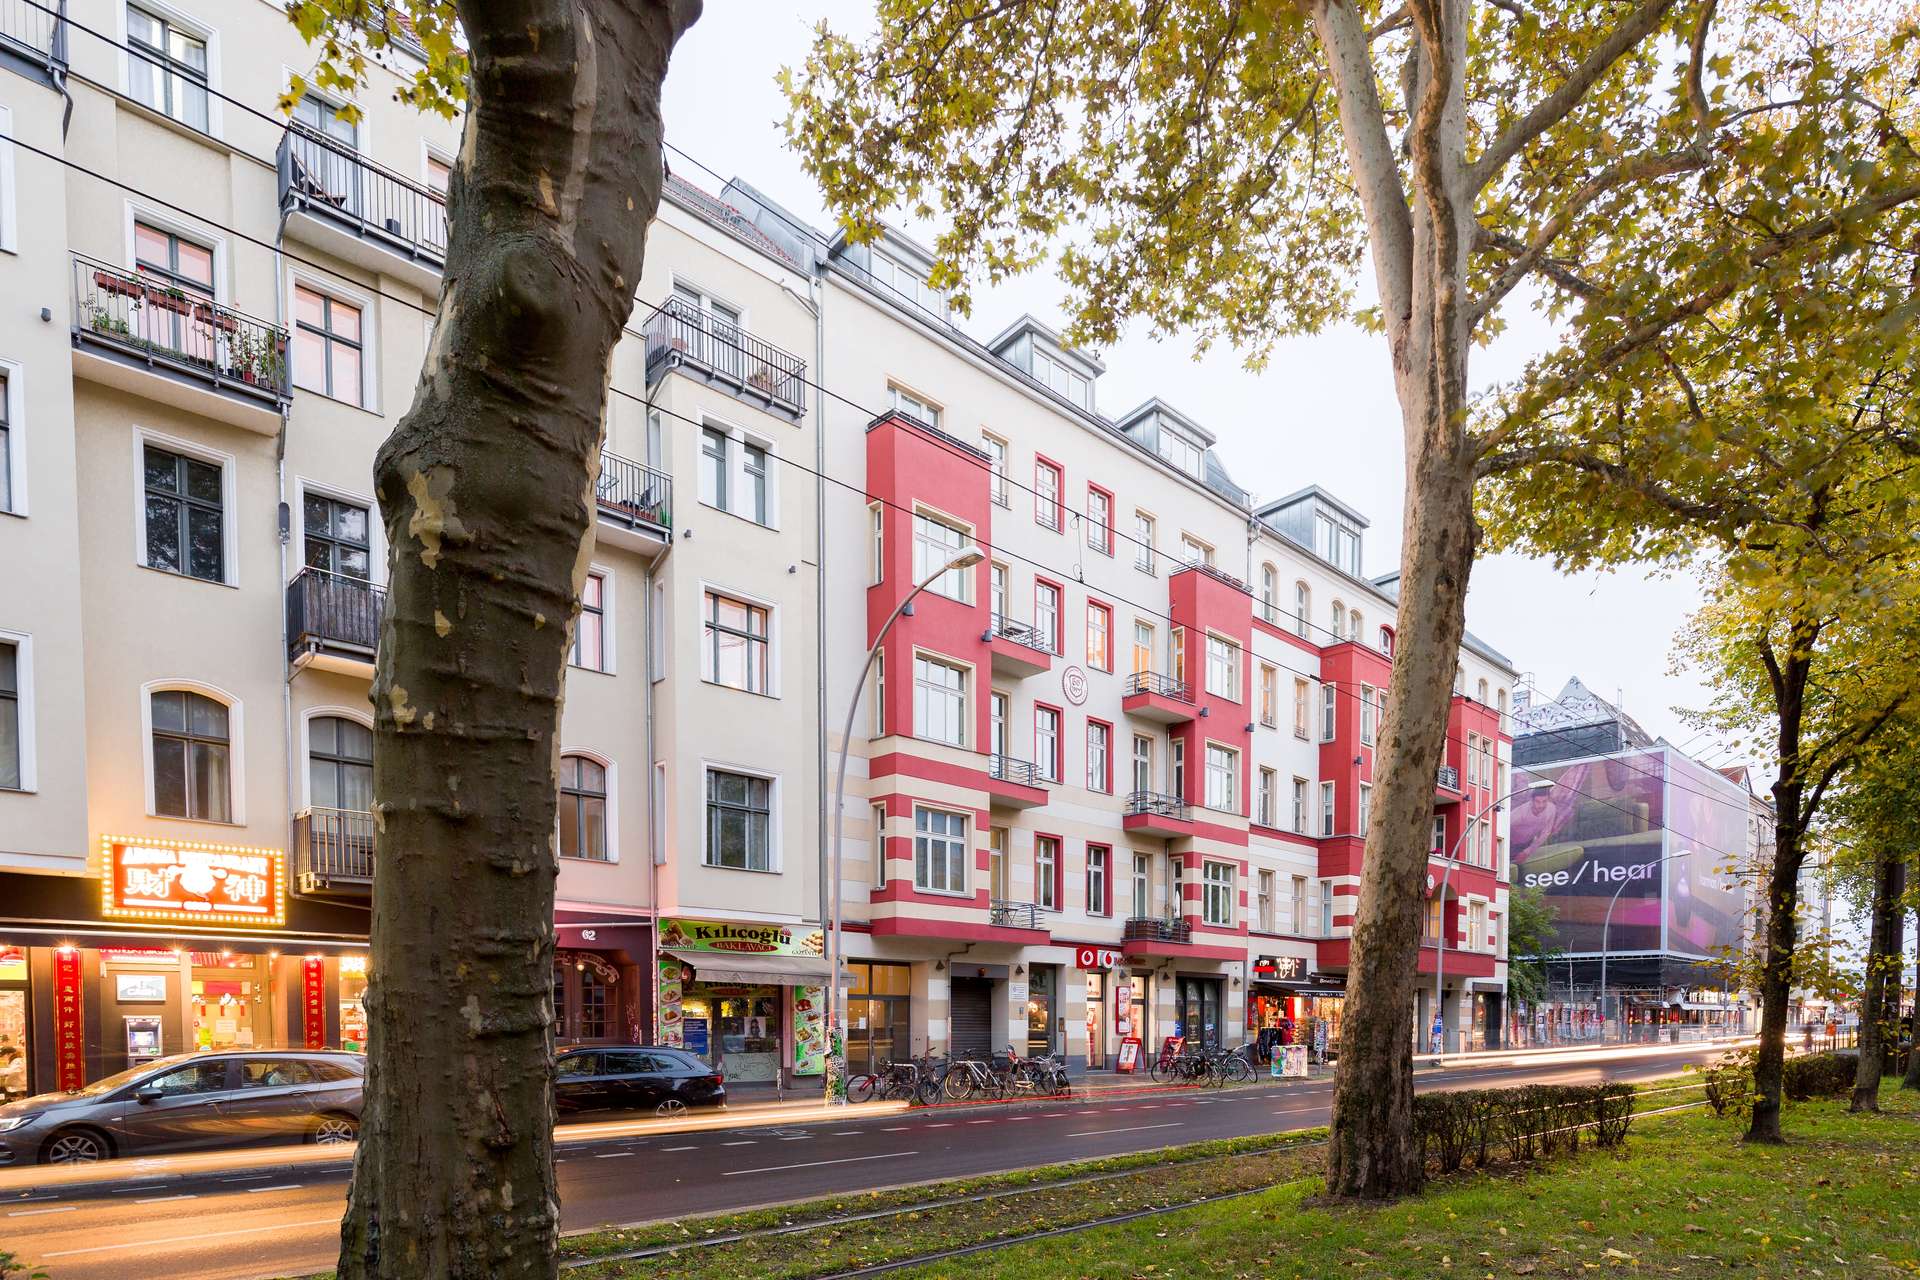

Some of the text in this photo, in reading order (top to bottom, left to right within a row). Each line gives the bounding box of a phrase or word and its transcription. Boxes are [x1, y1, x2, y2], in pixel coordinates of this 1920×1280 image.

[1524, 870, 1569, 888] see
[1593, 860, 1657, 882] hear
[582, 929, 596, 941] 62
